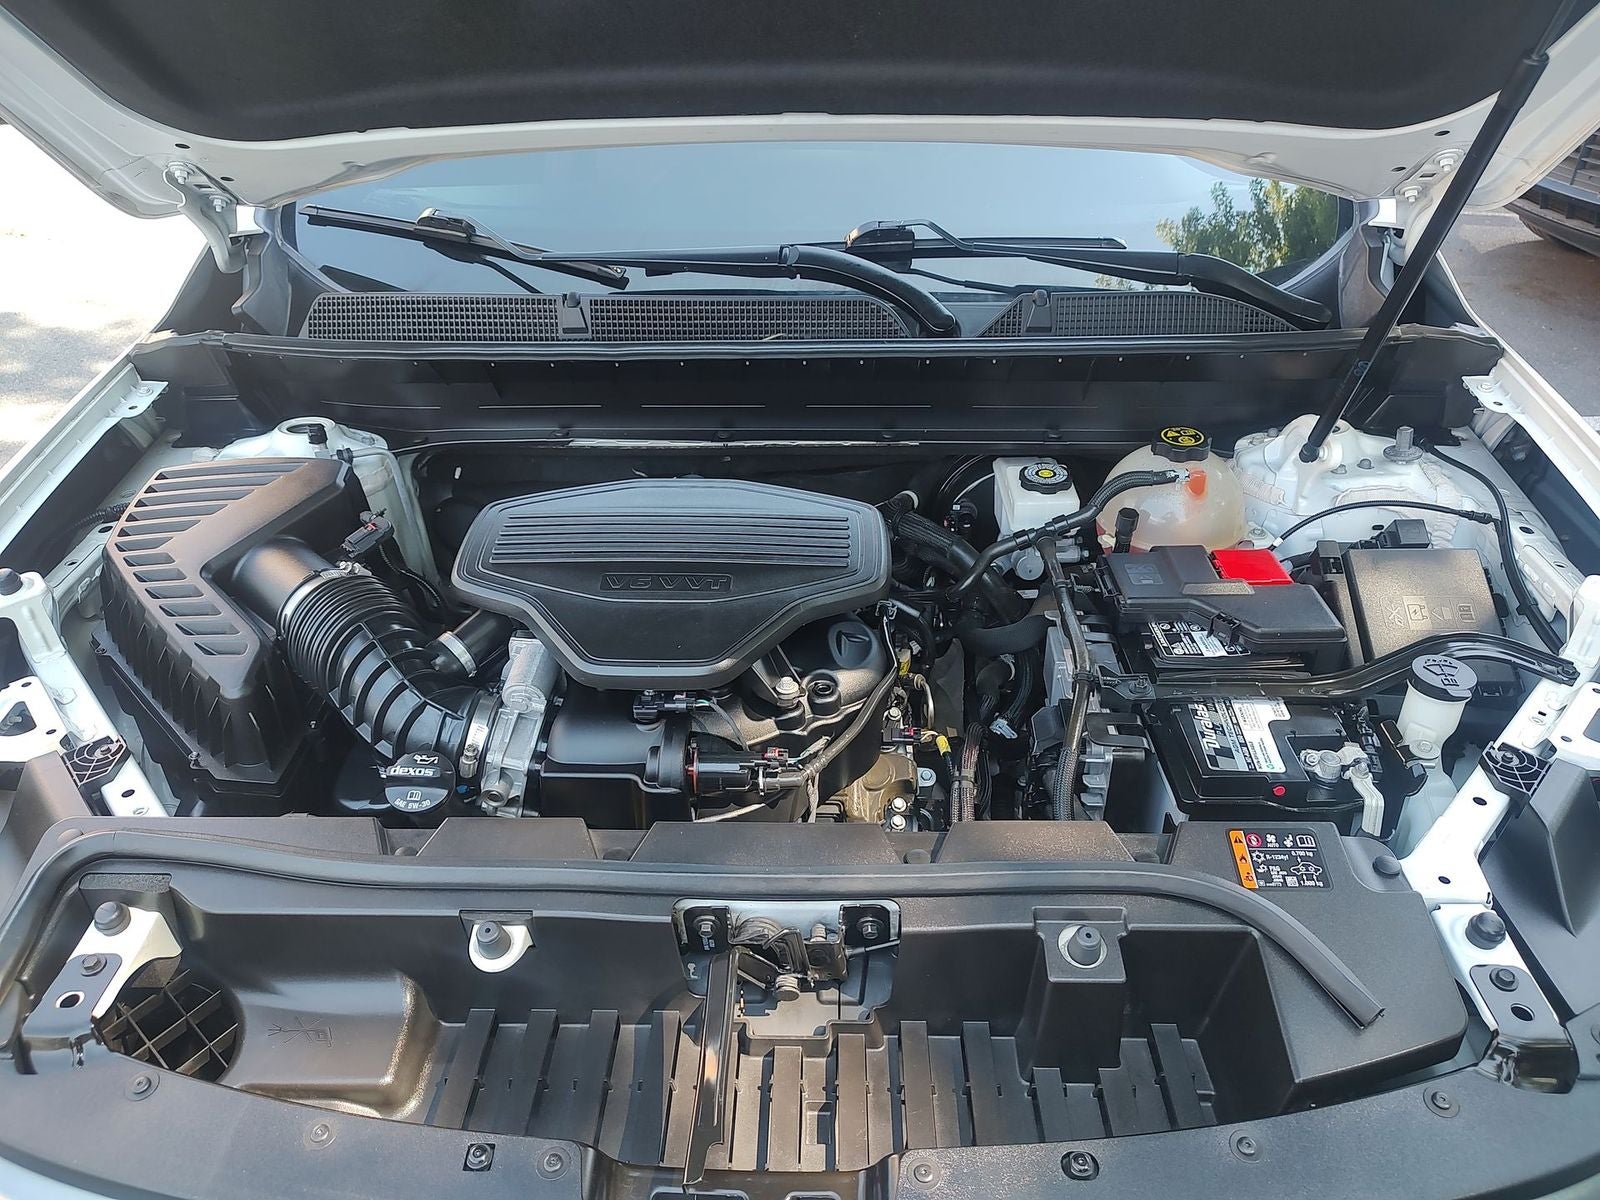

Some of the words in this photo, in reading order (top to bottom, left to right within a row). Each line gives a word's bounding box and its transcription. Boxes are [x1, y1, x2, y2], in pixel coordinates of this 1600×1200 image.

[607, 576, 652, 589] V6
[659, 576, 728, 590] VVT
[1195, 702, 1221, 750] Duralas
[390, 765, 435, 776] dexos
[394, 798, 407, 808] SAE
[407, 799, 431, 809] 5W-30
